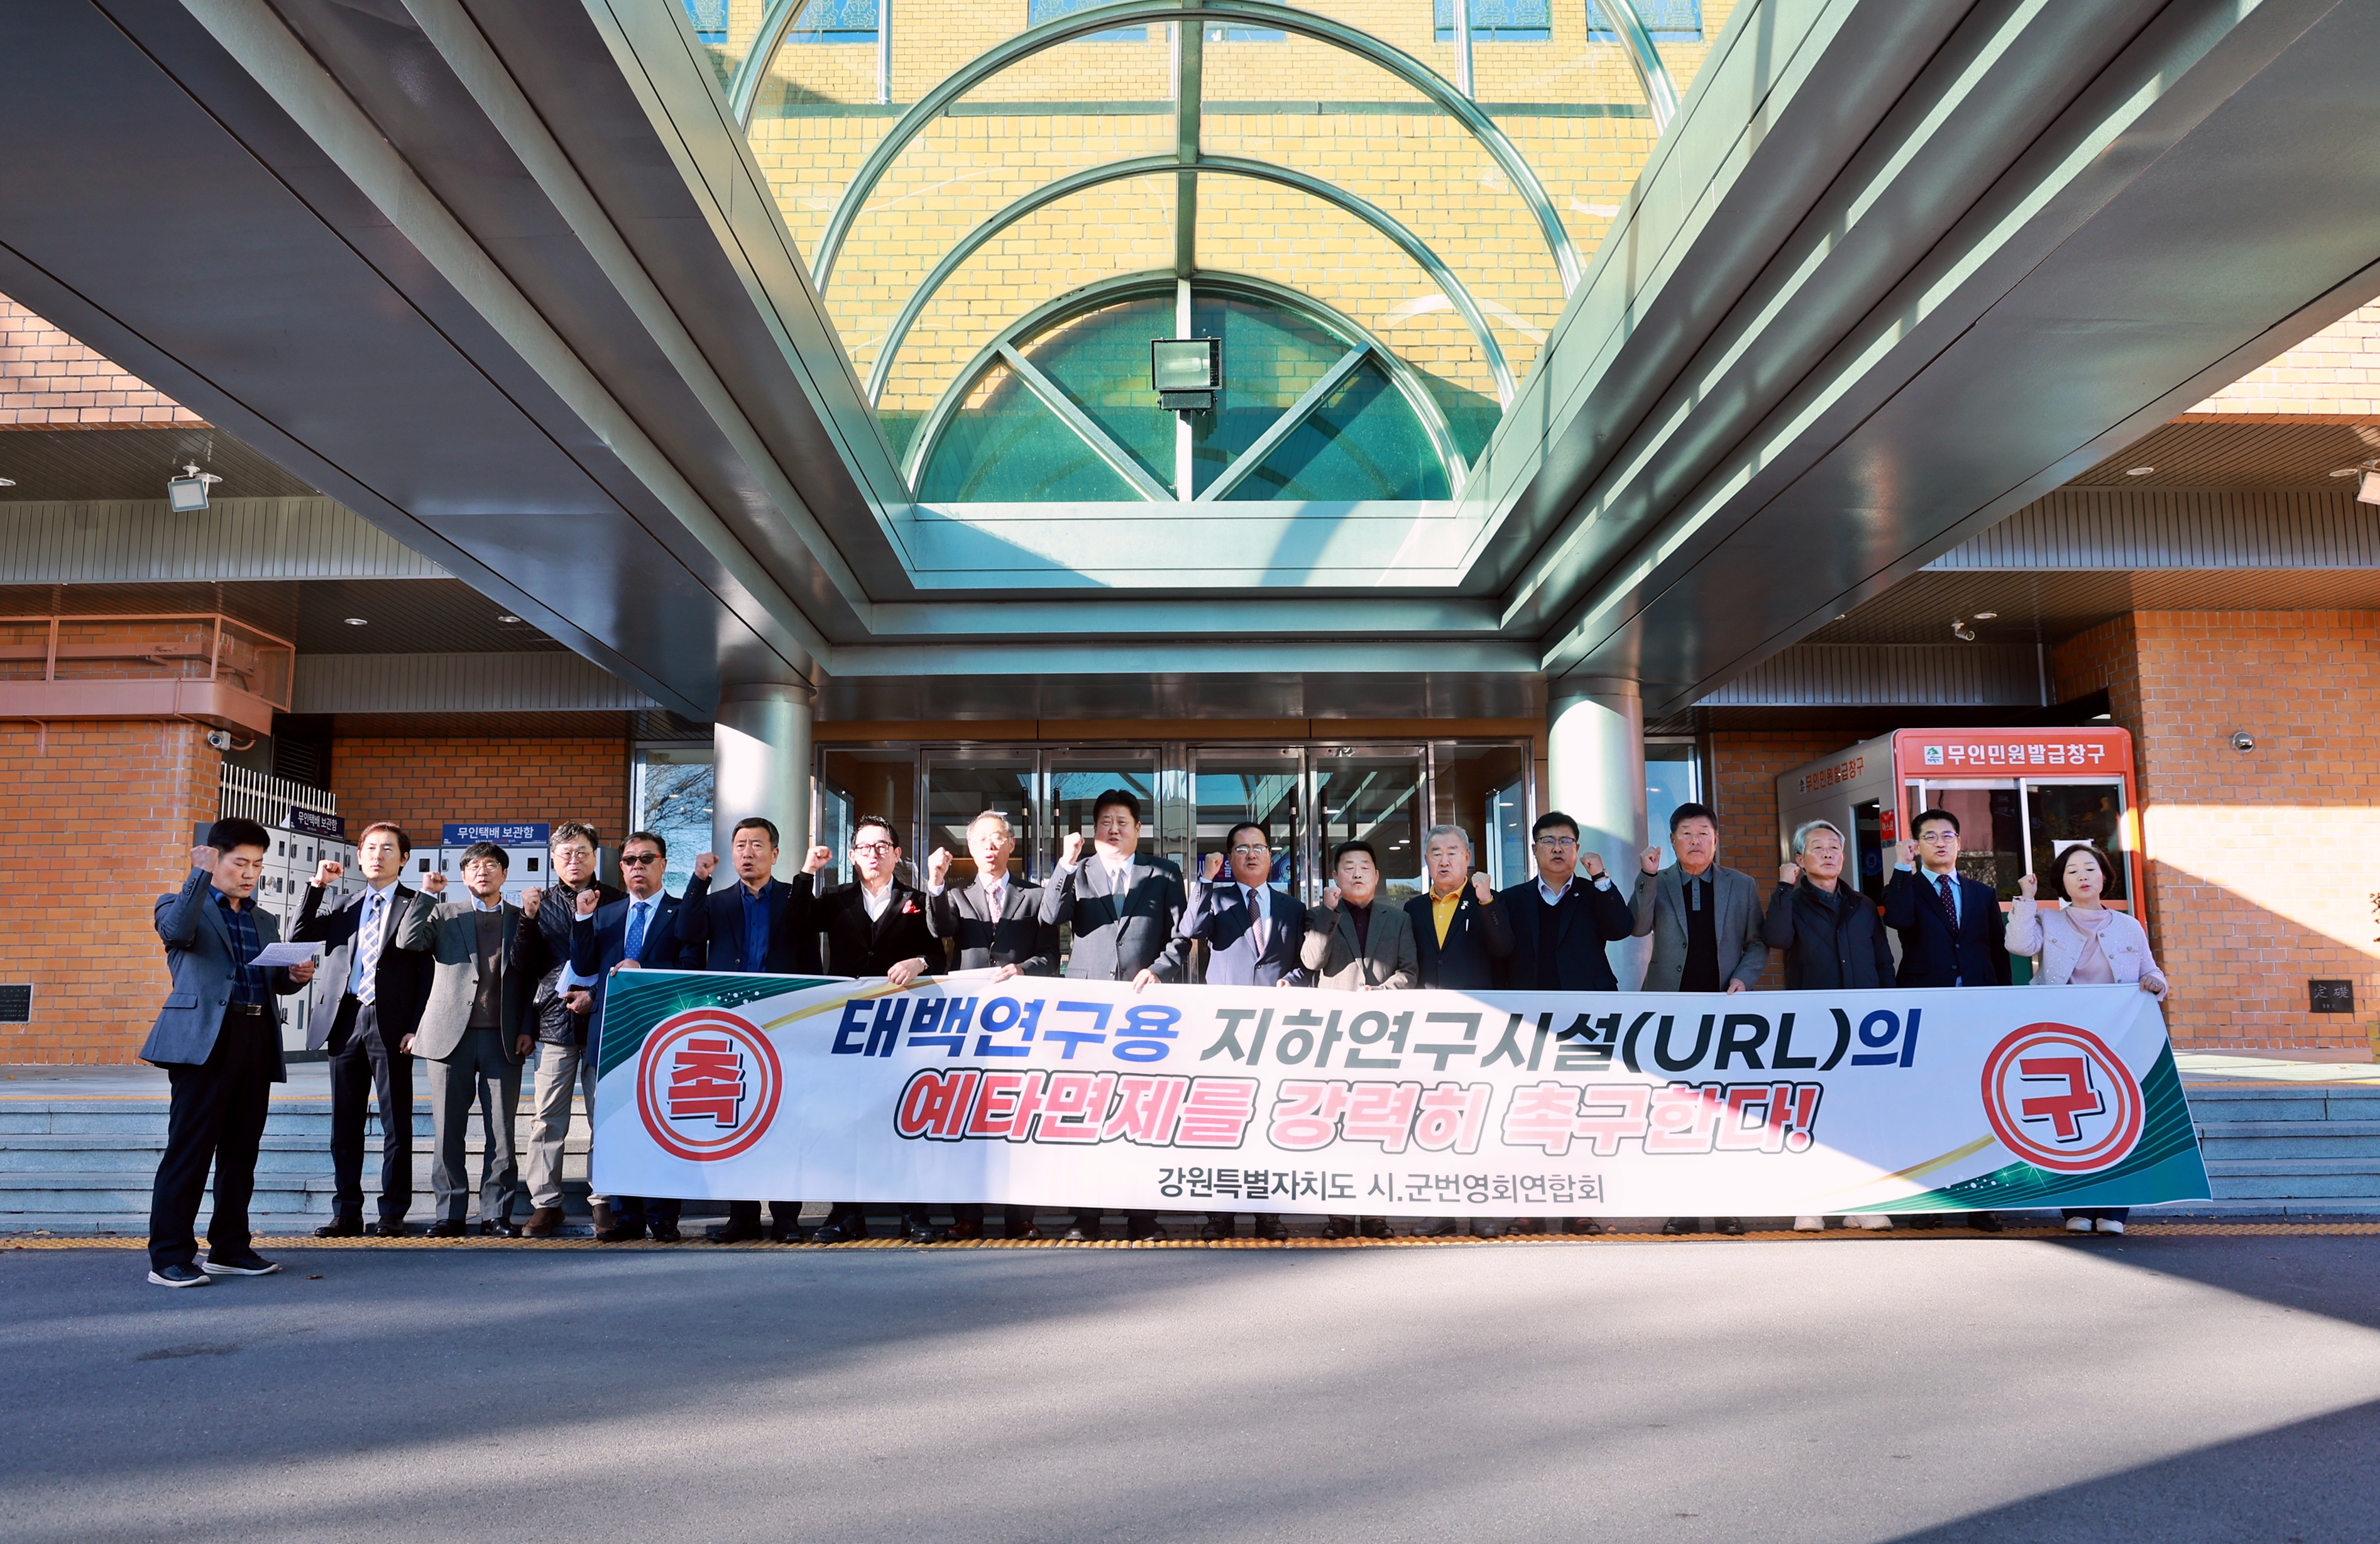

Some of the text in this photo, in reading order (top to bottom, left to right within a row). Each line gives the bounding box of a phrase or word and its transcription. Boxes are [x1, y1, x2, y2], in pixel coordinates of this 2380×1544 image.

[1948, 744, 2105, 765] 무인민원발급창구
[1806, 756, 1865, 793] 무인민원발급창구
[297, 811, 321, 828] 무인택배
[321, 817, 337, 832] 보관함
[458, 827, 534, 839] 무인택배 보관함
[831, 996, 1922, 1073] 태백연구용 지하연구시설(URL)의
[667, 1037, 747, 1128] 촉
[2019, 1054, 2106, 1144] 구
[894, 1067, 1824, 1157] 예타면제를 강력히 촉구한다!
[1158, 1167, 1605, 1205] 강원특별자치도 시.군번영회연합회
